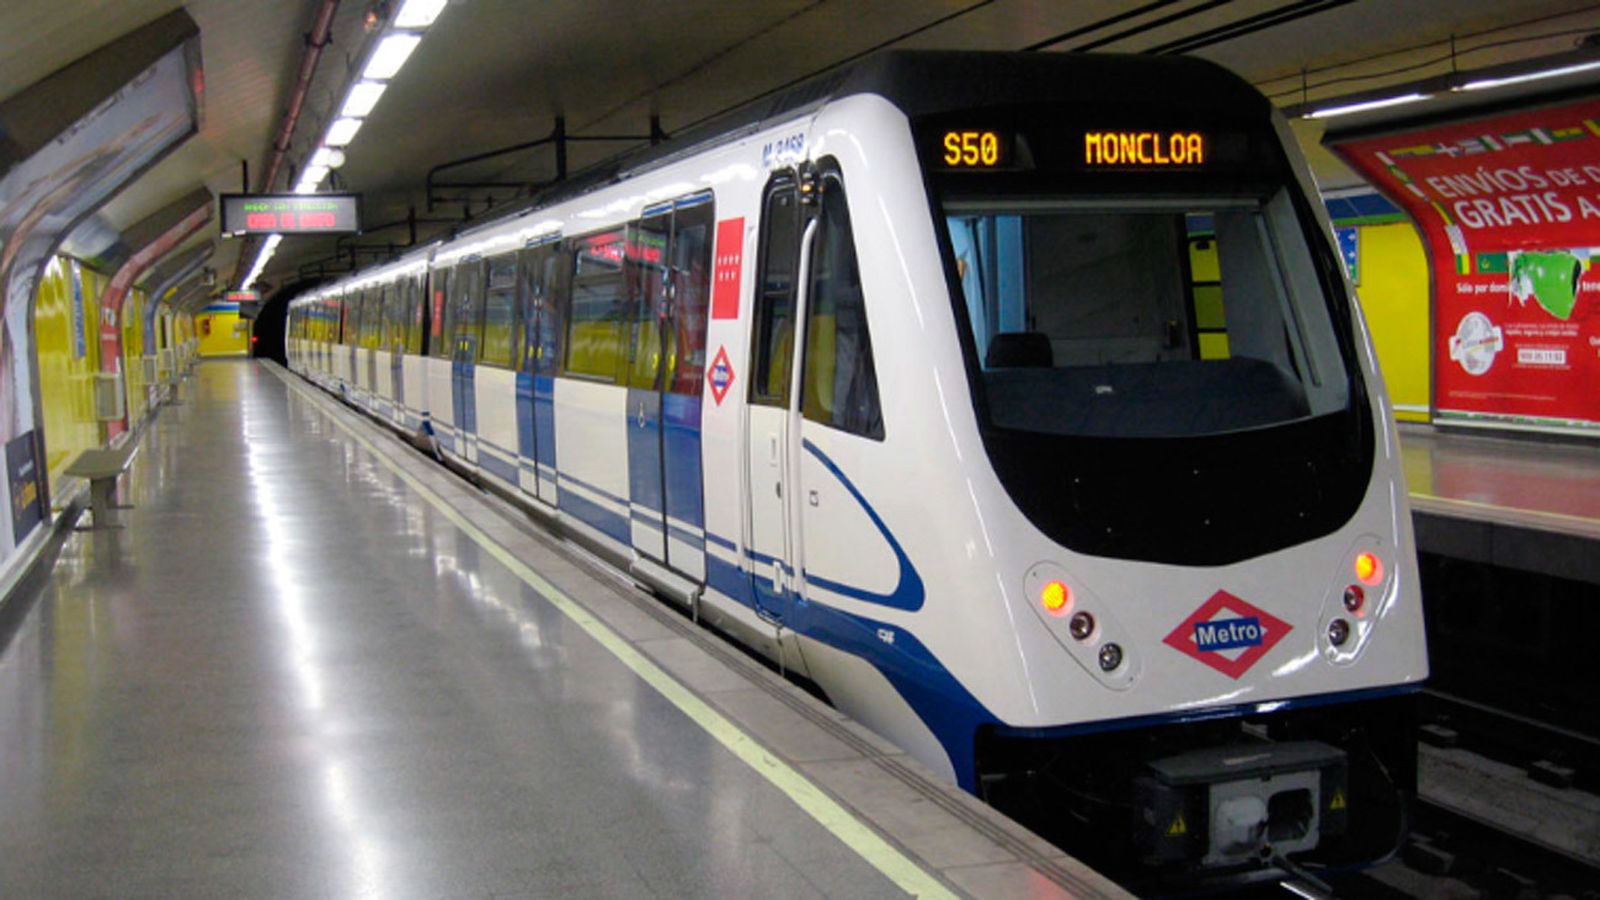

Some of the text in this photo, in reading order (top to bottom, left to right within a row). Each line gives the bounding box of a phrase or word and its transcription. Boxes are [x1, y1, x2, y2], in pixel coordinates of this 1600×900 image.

[944, 132, 997, 165] S50
[1085, 132, 1203, 164] MONCLOA
[1545, 167, 1587, 187] DE
[1453, 191, 1572, 229] GRATIS
[1197, 621, 1259, 646] Metro
